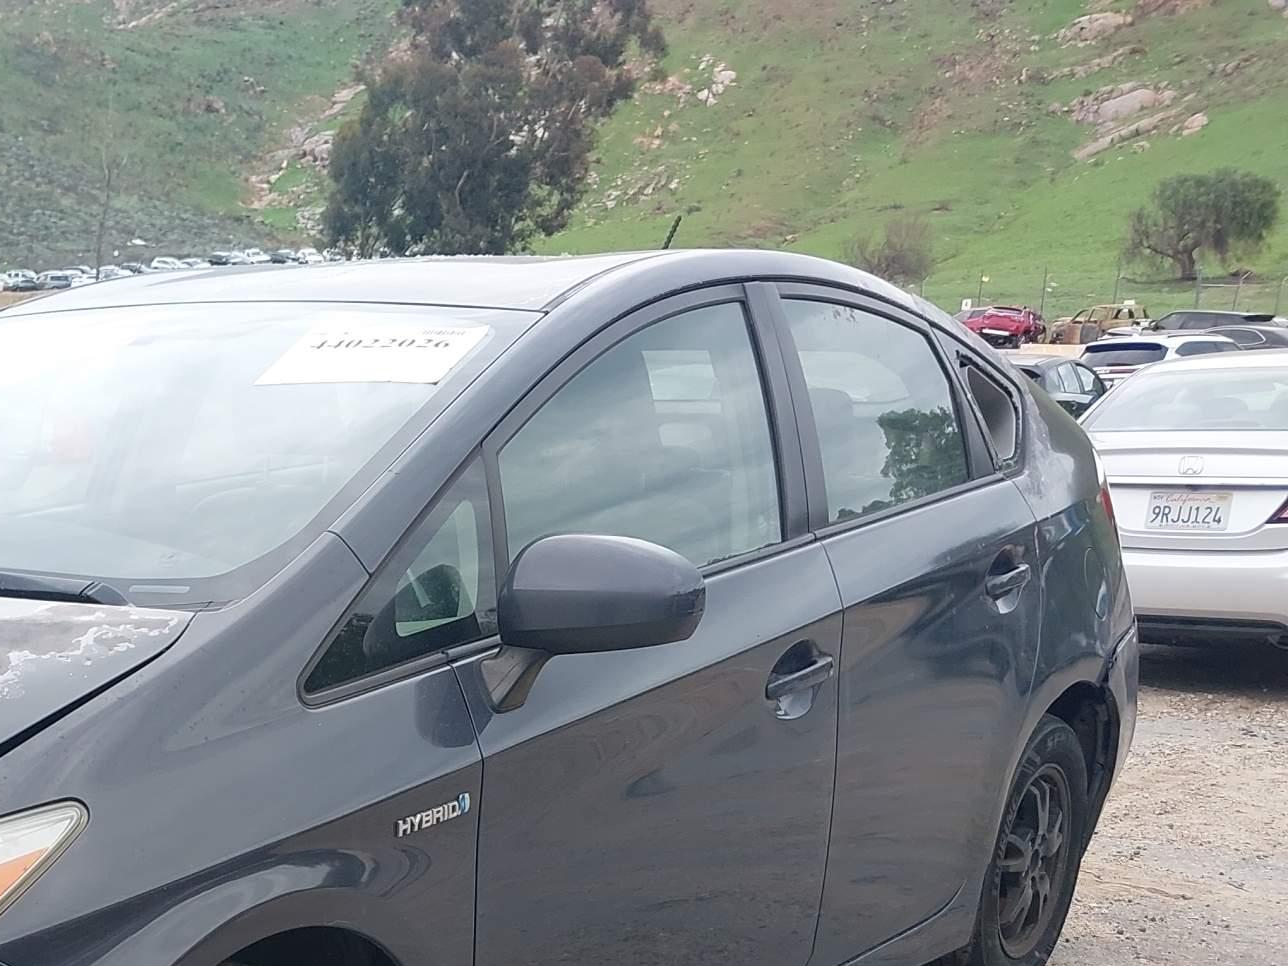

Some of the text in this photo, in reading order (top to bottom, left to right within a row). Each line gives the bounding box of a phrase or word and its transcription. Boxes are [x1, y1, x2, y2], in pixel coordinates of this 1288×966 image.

[310, 337, 450, 350] 44022026
[1165, 494, 1211, 505] California
[1150, 505, 1222, 525] 9RJJ124
[396, 800, 462, 838] HYBRID
